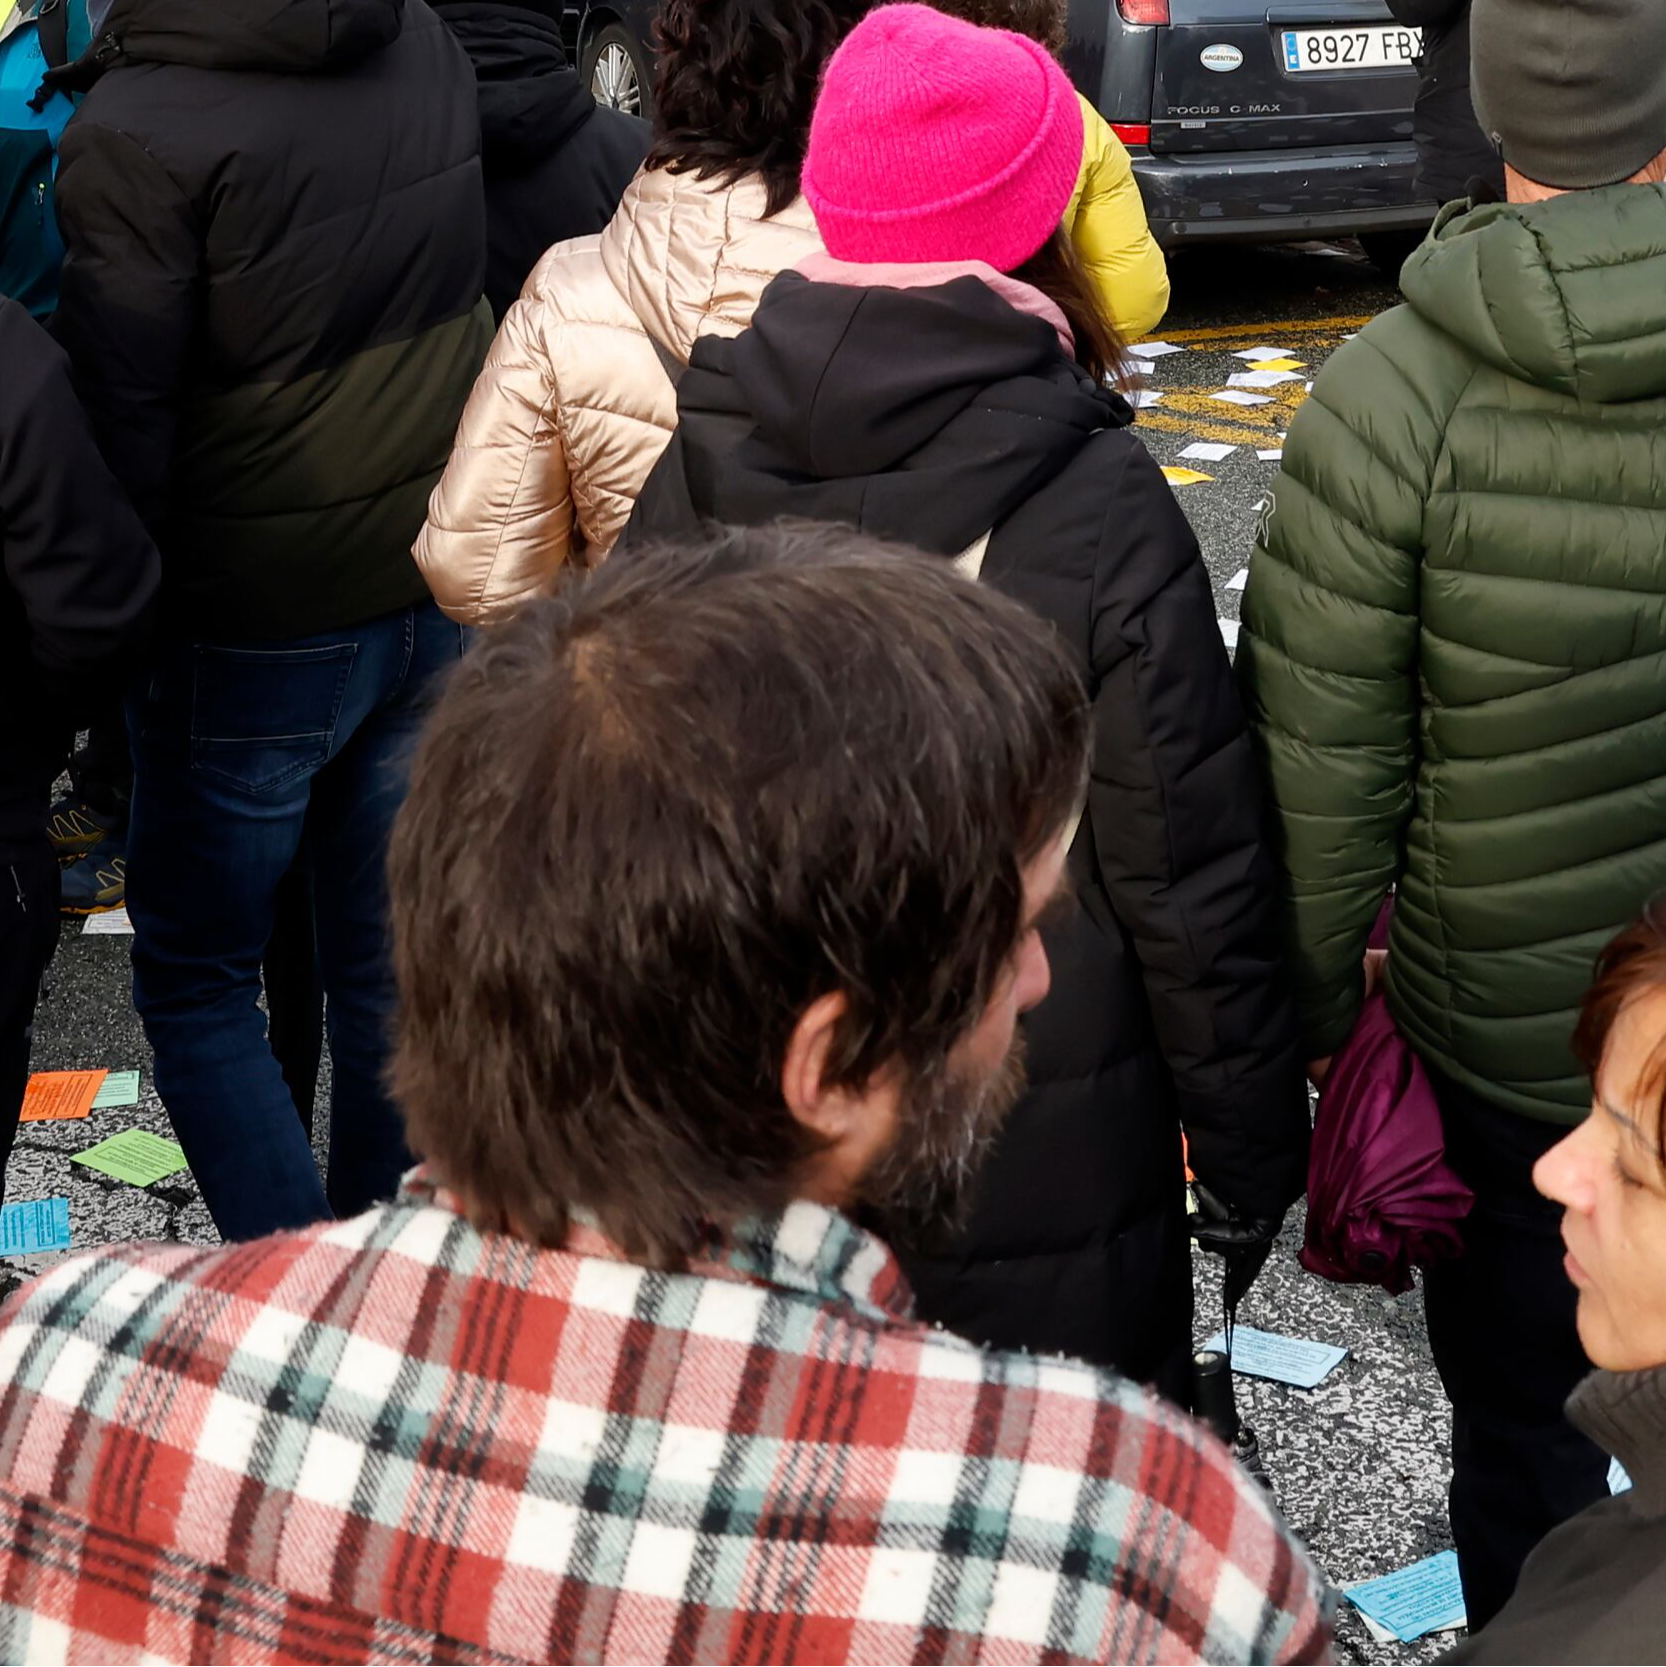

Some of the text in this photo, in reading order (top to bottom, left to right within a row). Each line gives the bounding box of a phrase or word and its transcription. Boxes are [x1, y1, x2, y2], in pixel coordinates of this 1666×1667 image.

[1306, 34, 1369, 64] 8927
[1203, 53, 1240, 63] ARGENTINA
[1167, 105, 1221, 115] FOCUS
